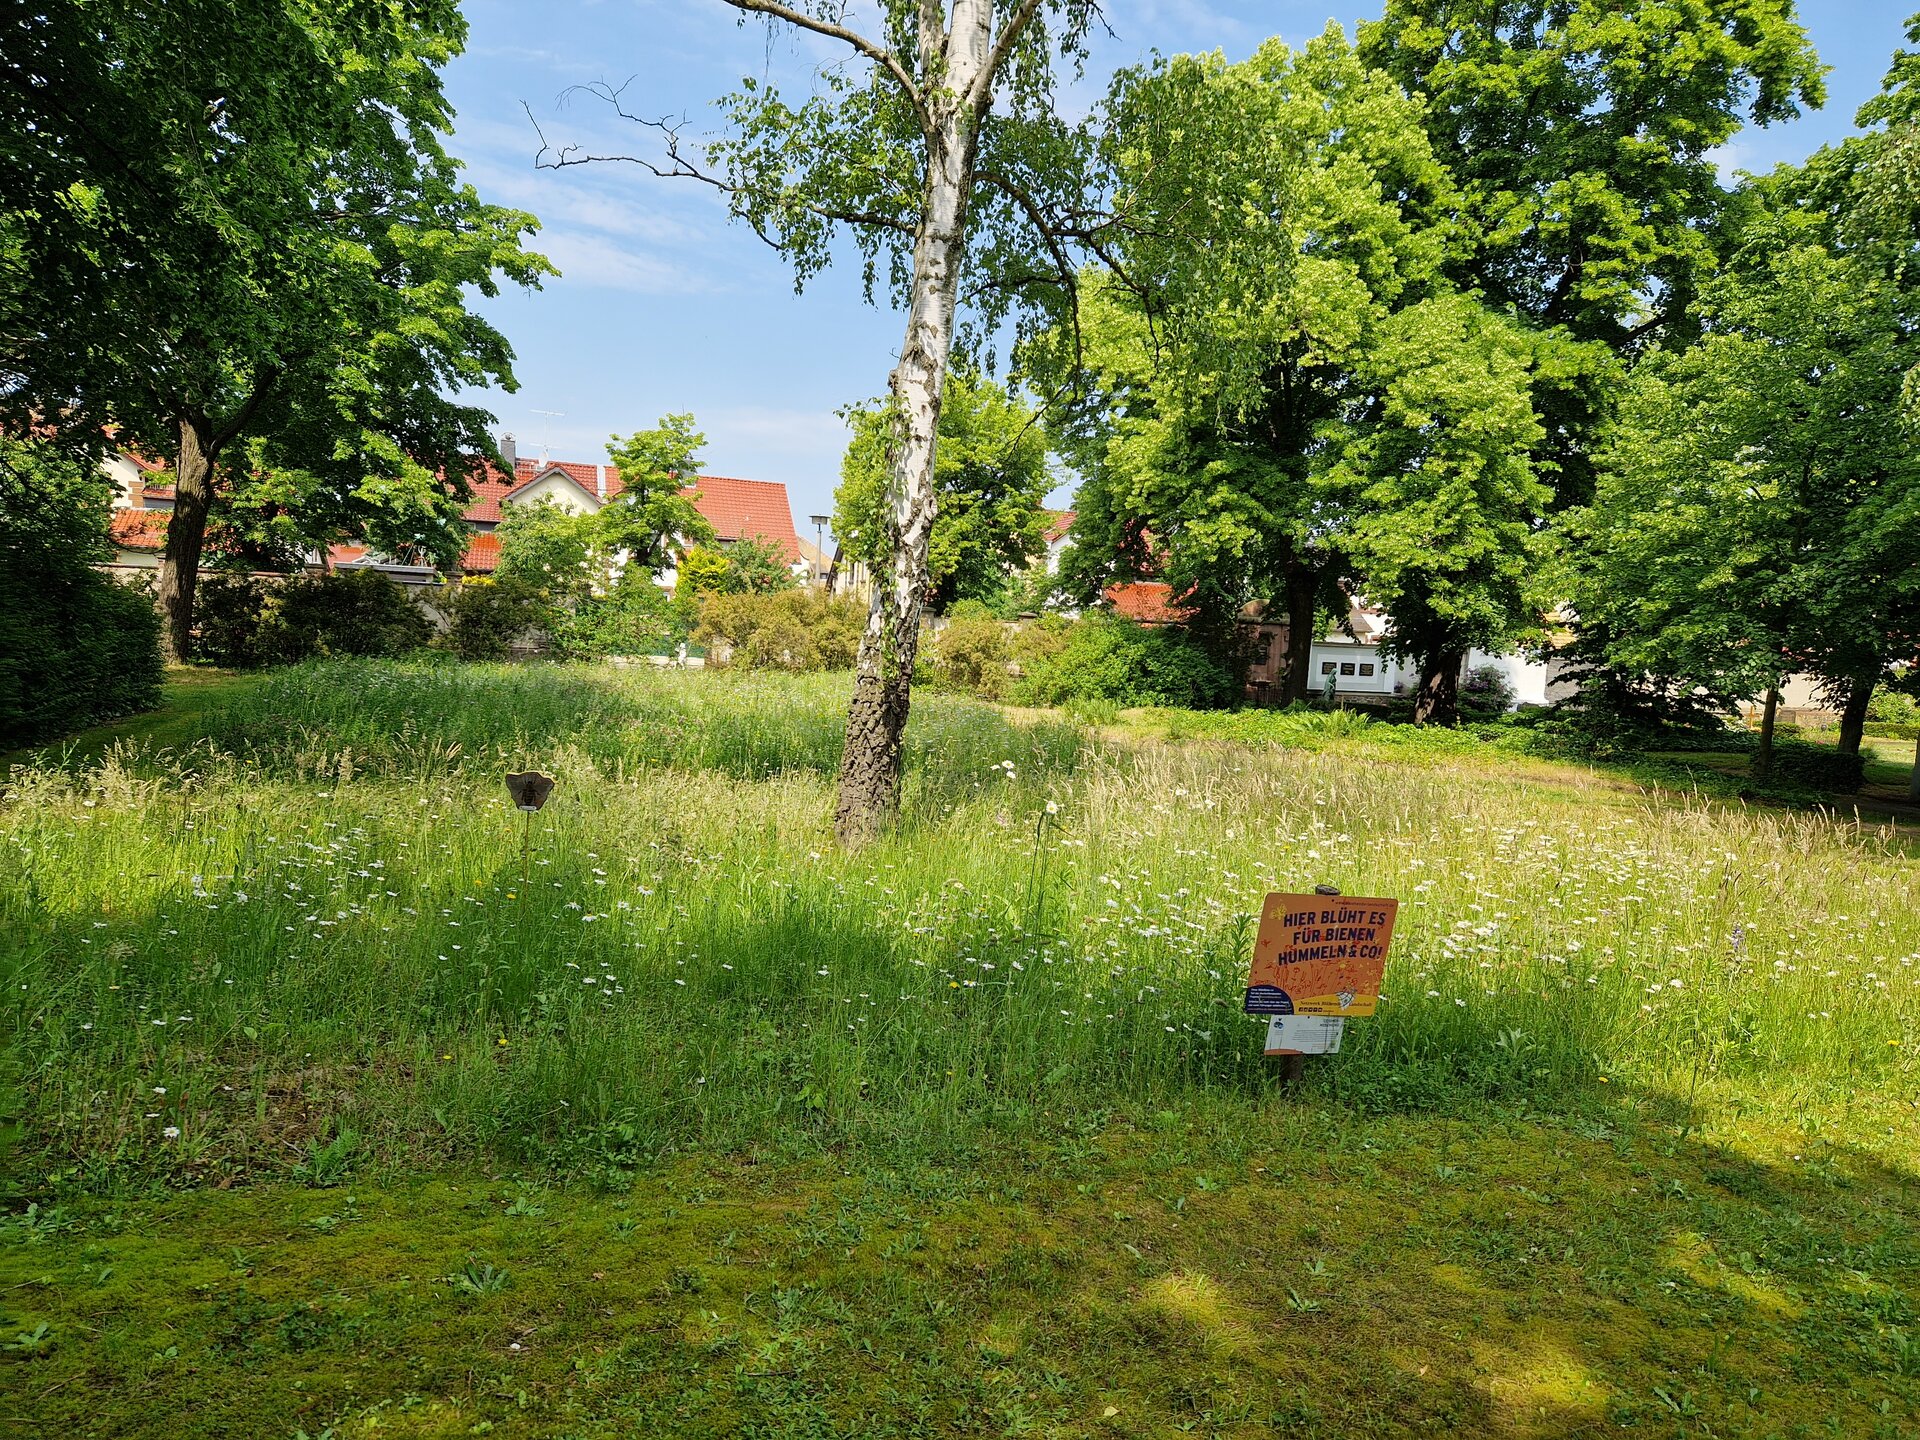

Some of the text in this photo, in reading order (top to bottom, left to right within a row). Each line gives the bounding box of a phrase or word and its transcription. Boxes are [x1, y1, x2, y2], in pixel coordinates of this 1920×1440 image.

[1284, 907, 1386, 927] HIER BLÜHT ES
[1293, 928, 1321, 945] FÜR
[1278, 944, 1383, 966] HUMMELN & CO!
